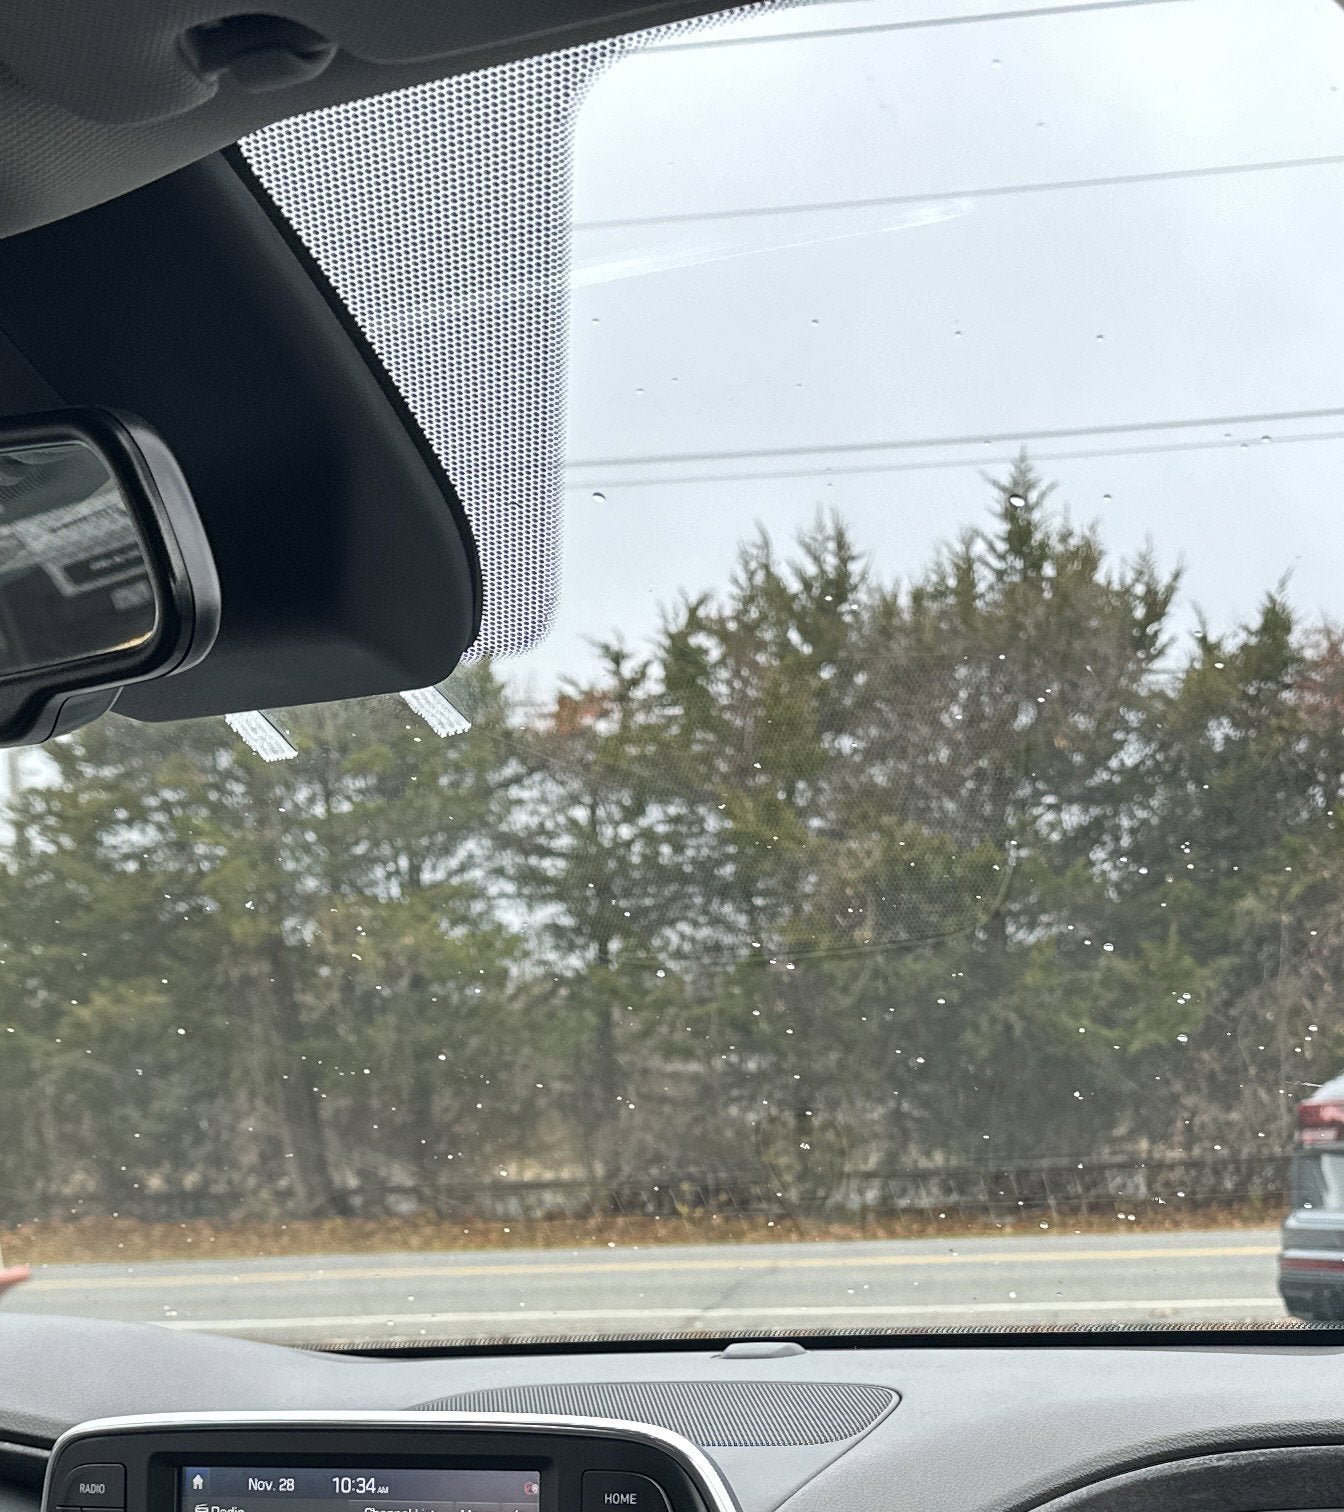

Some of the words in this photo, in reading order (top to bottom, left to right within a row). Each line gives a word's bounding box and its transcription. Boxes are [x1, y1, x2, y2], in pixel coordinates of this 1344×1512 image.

[79, 1482, 106, 1495] RADIO
[248, 1478, 276, 1492] Nov.
[278, 1478, 295, 1492] 28
[332, 1477, 376, 1494] 10:34
[604, 1493, 637, 1505] HOME
